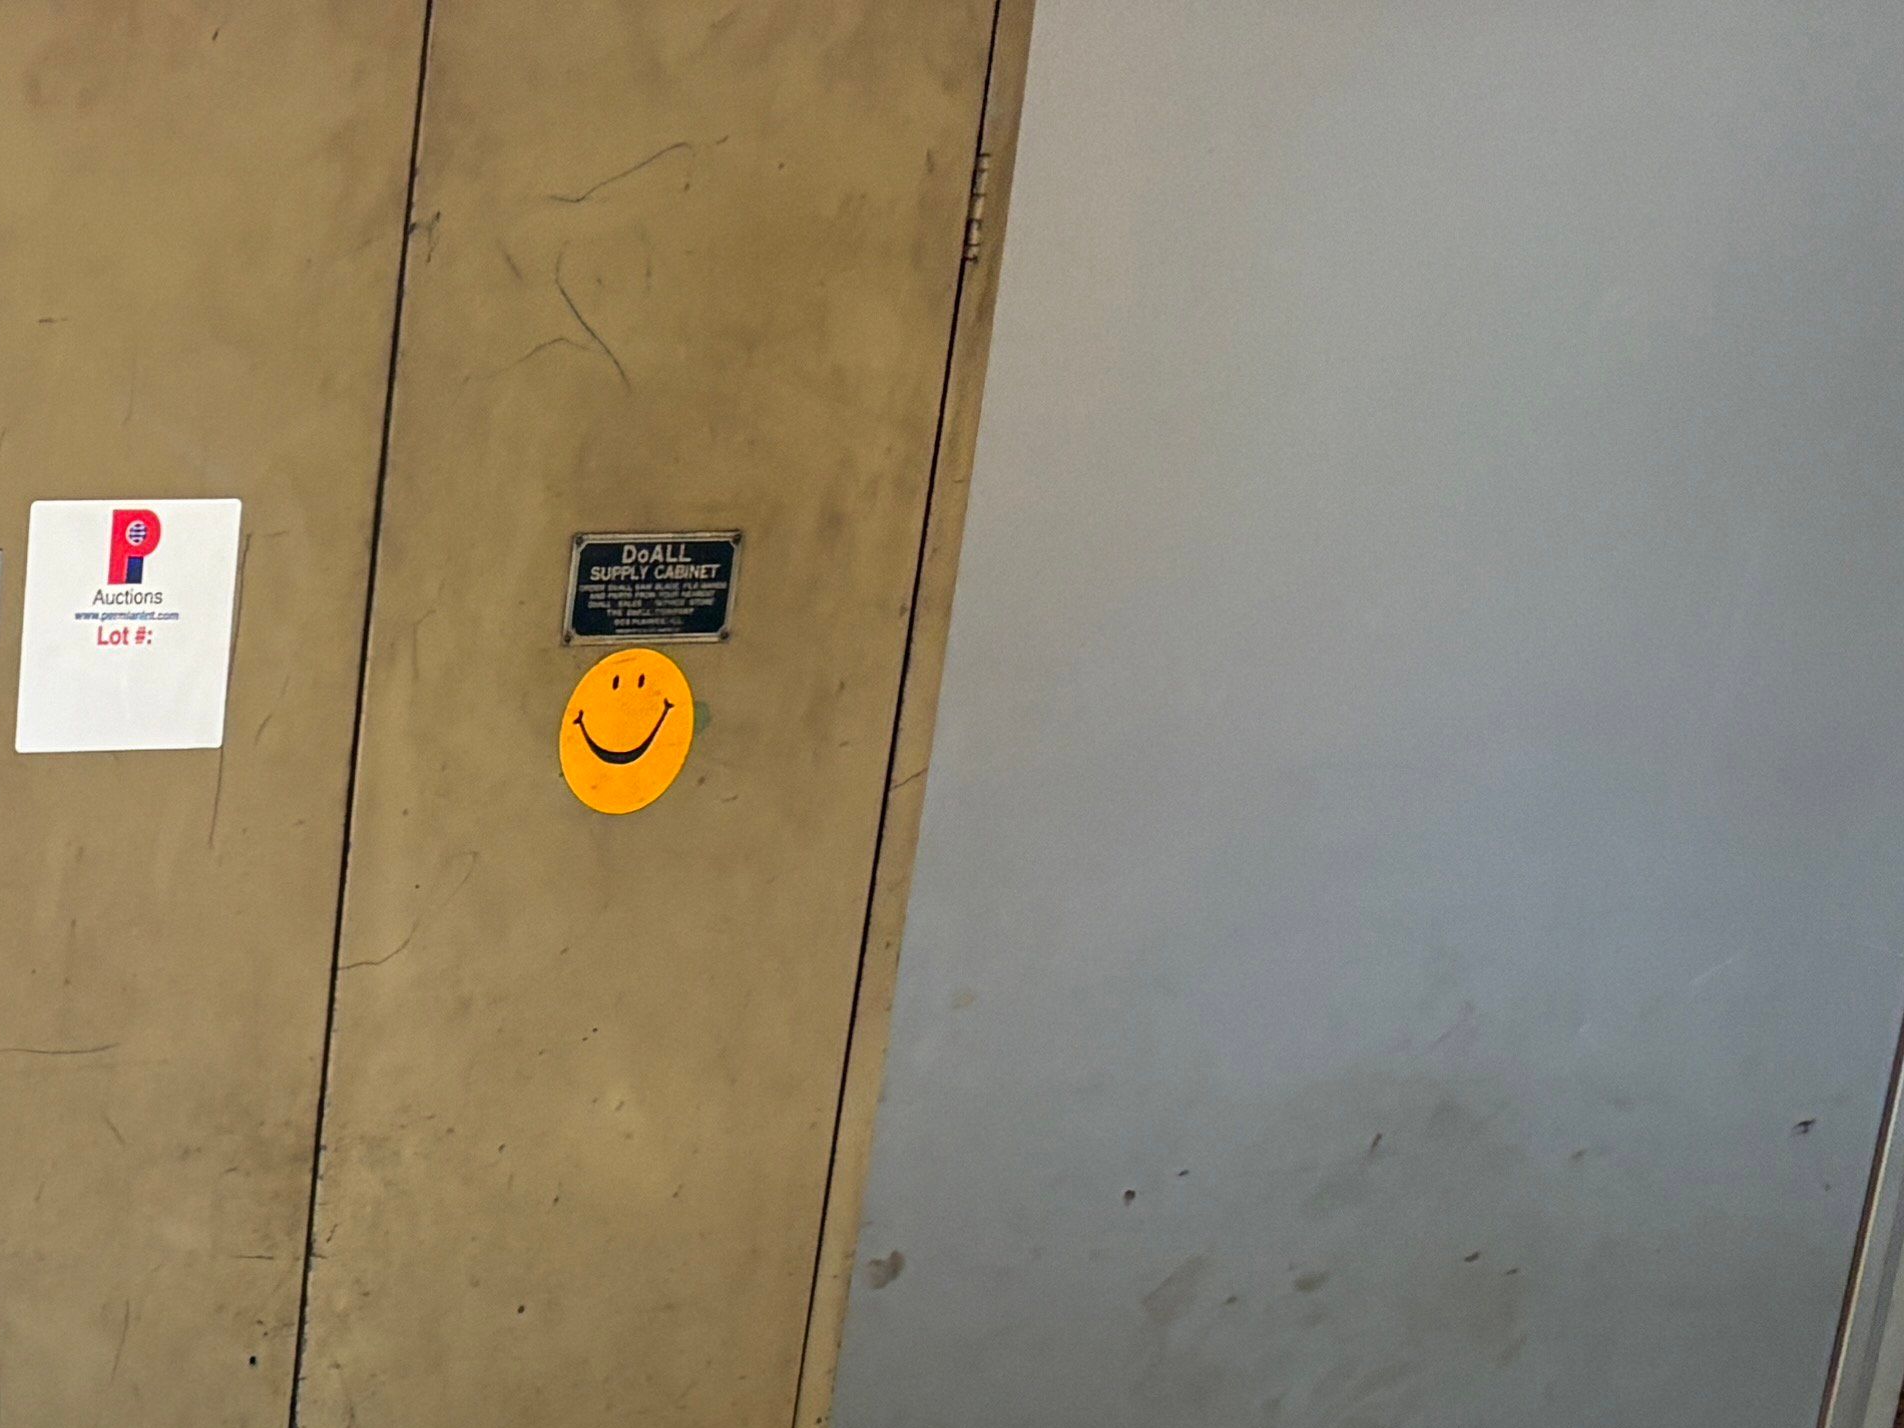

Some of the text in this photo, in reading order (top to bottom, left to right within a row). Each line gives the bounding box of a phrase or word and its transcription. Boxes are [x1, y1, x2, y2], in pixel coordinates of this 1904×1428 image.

[621, 543, 692, 564] DoALL
[589, 563, 721, 582] SUPPLY CABINET
[92, 588, 164, 606] Auctions
[97, 626, 153, 646] Lot #:
